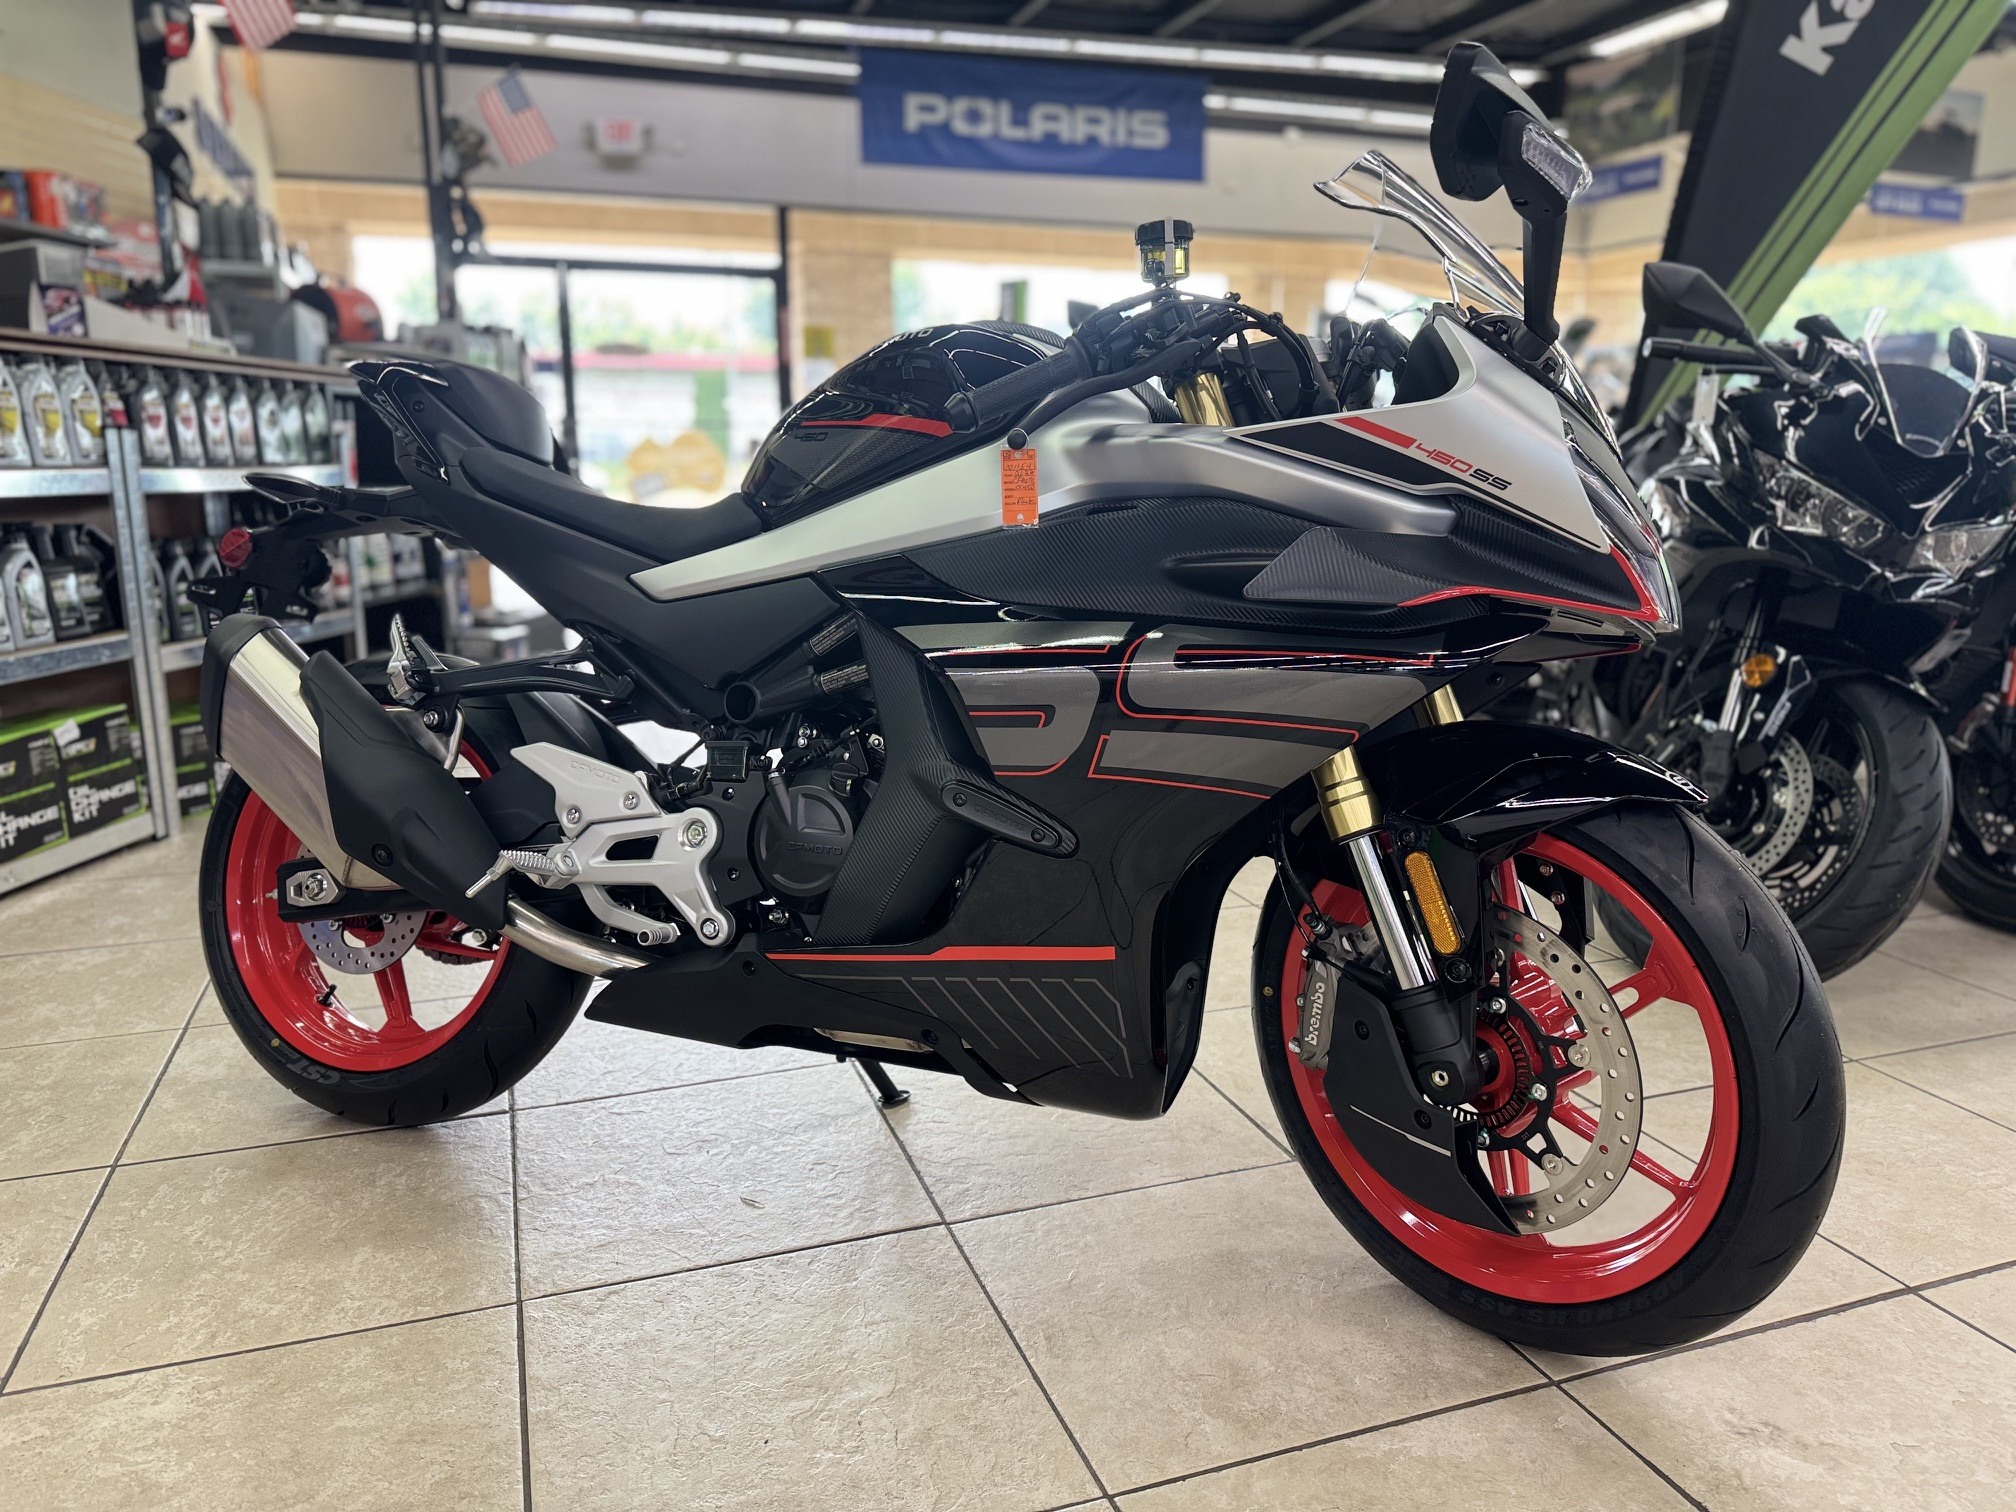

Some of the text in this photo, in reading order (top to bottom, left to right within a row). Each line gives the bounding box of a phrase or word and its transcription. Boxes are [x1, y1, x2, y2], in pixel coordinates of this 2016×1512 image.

[903, 92, 1169, 150] POLARIS
[794, 431, 829, 442] 450
[1415, 442, 1513, 491] 450 SS
[69, 779, 136, 812] CHANGE
[0, 804, 59, 836] HANGE
[72, 802, 100, 823] KIT
[787, 841, 843, 856] CFMOTO
[1304, 981, 1326, 1046] brembo
[286, 1059, 341, 1085] CST
